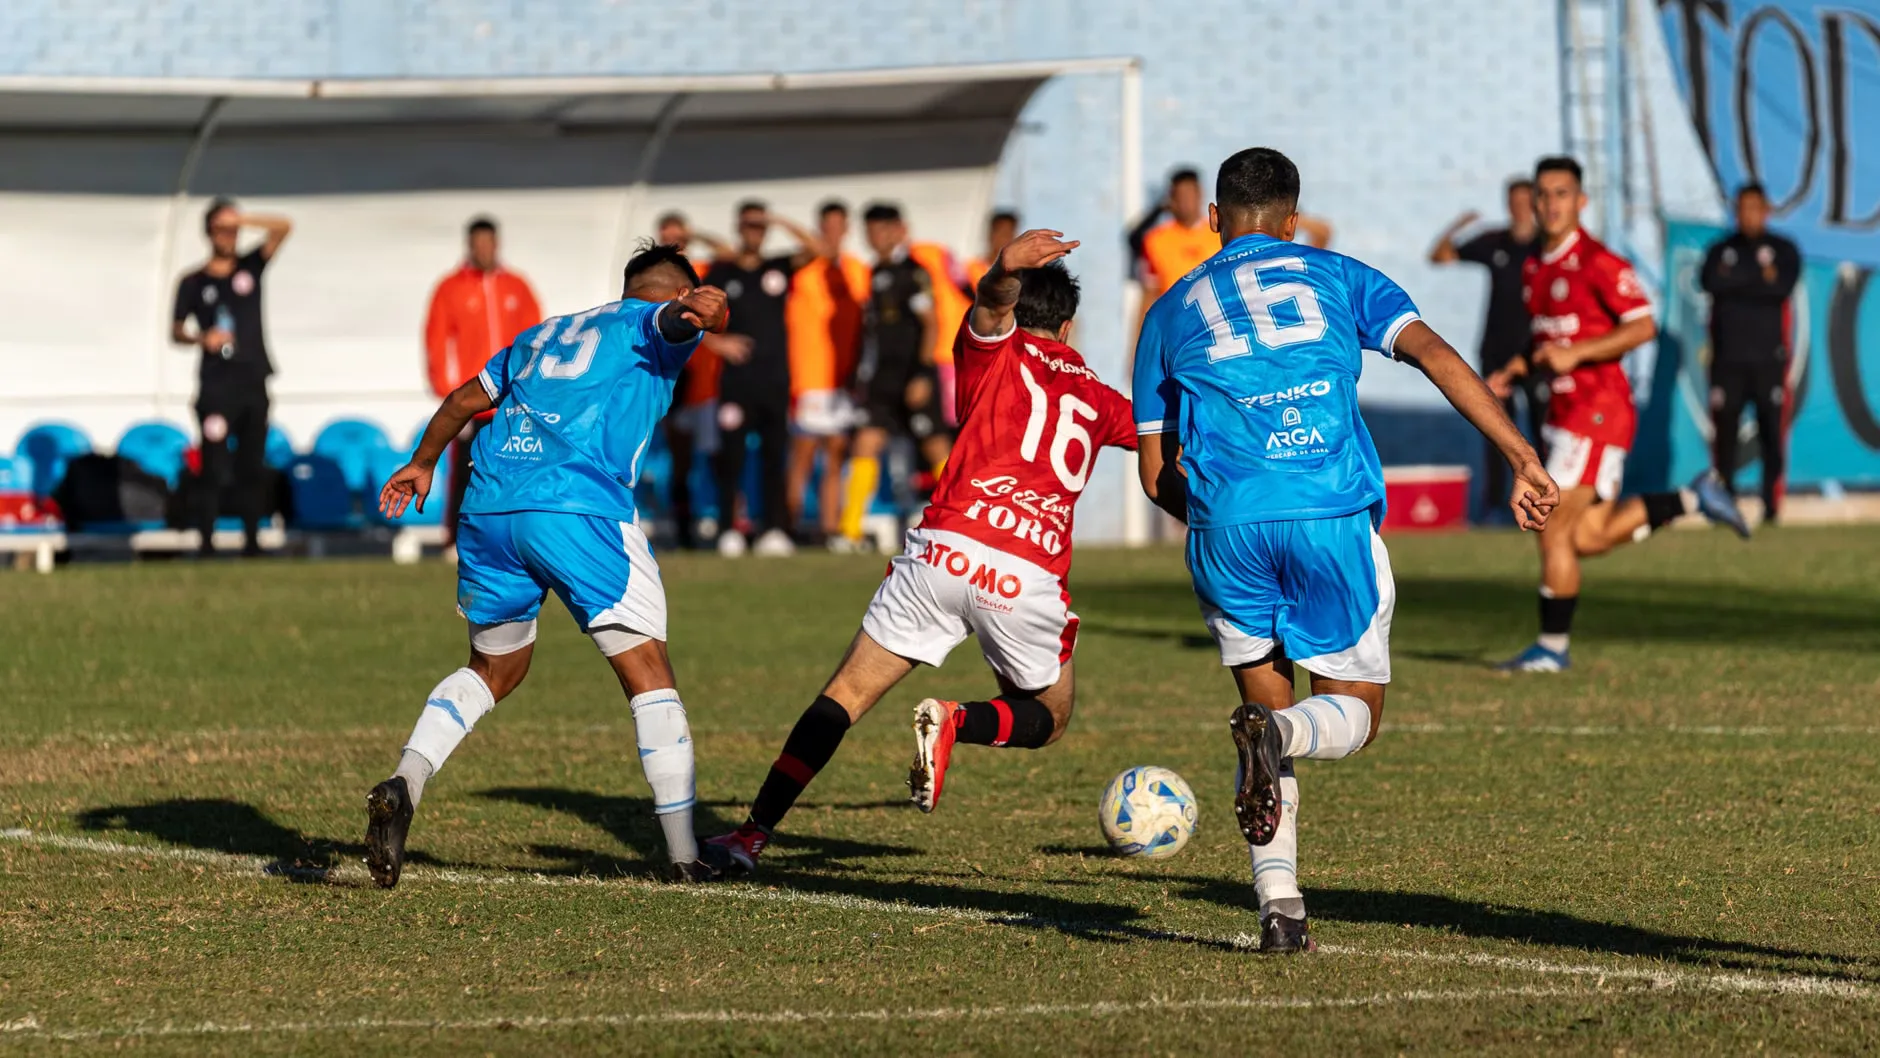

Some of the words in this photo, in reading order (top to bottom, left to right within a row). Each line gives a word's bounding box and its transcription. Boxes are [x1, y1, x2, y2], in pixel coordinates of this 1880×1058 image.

[515, 303, 623, 381] 15
[1182, 255, 1329, 364] 16
[501, 436, 544, 453] ARGA
[1019, 361, 1099, 493] 16
[1266, 426, 1325, 451] ARGA
